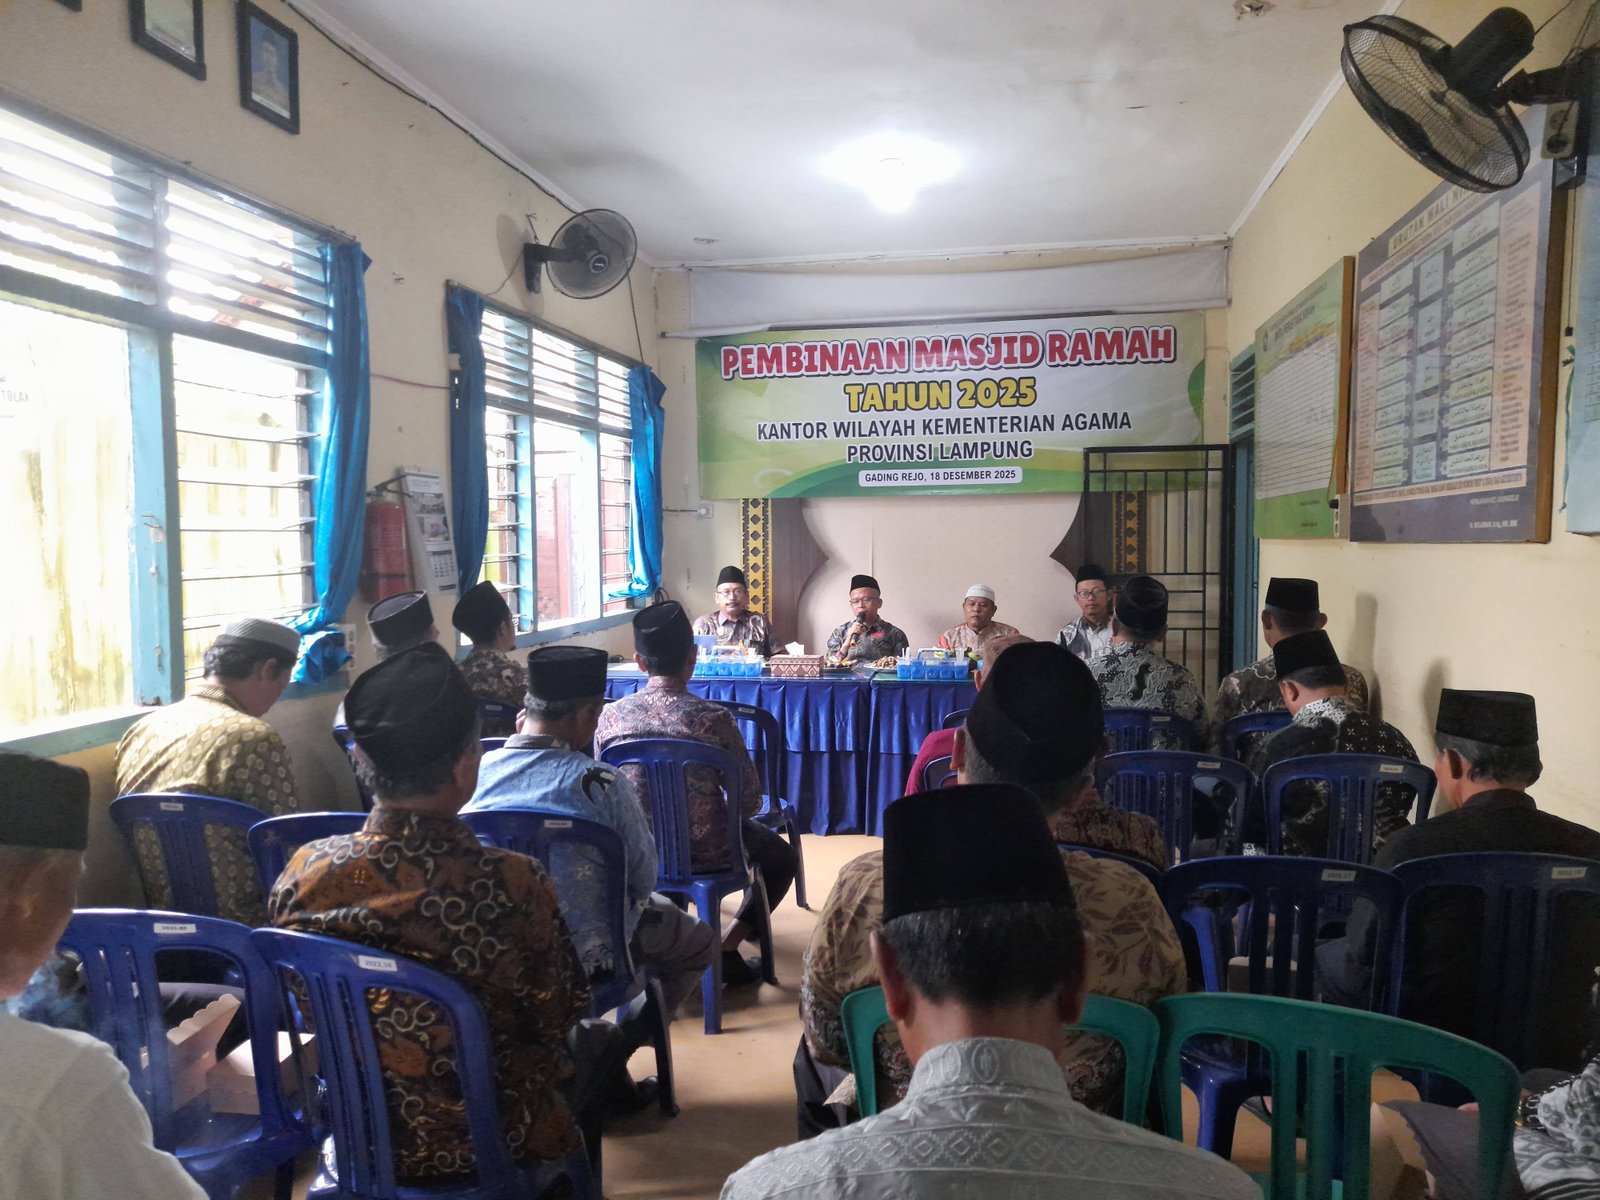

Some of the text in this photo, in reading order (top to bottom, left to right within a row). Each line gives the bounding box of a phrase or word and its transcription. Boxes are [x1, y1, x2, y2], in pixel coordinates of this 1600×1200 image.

[721, 327, 1175, 379] PEMBINAAN MASJID RAMAH
[844, 377, 1037, 413] TAHUN 2025
[757, 411, 1132, 441] KANTOR WILAYAH KEMENTERIAN AGAMA
[846, 440, 1034, 463] PROVINSI LAMPUNG
[864, 469, 1017, 483] GADING REJO, 18 DESEMBER 2025
